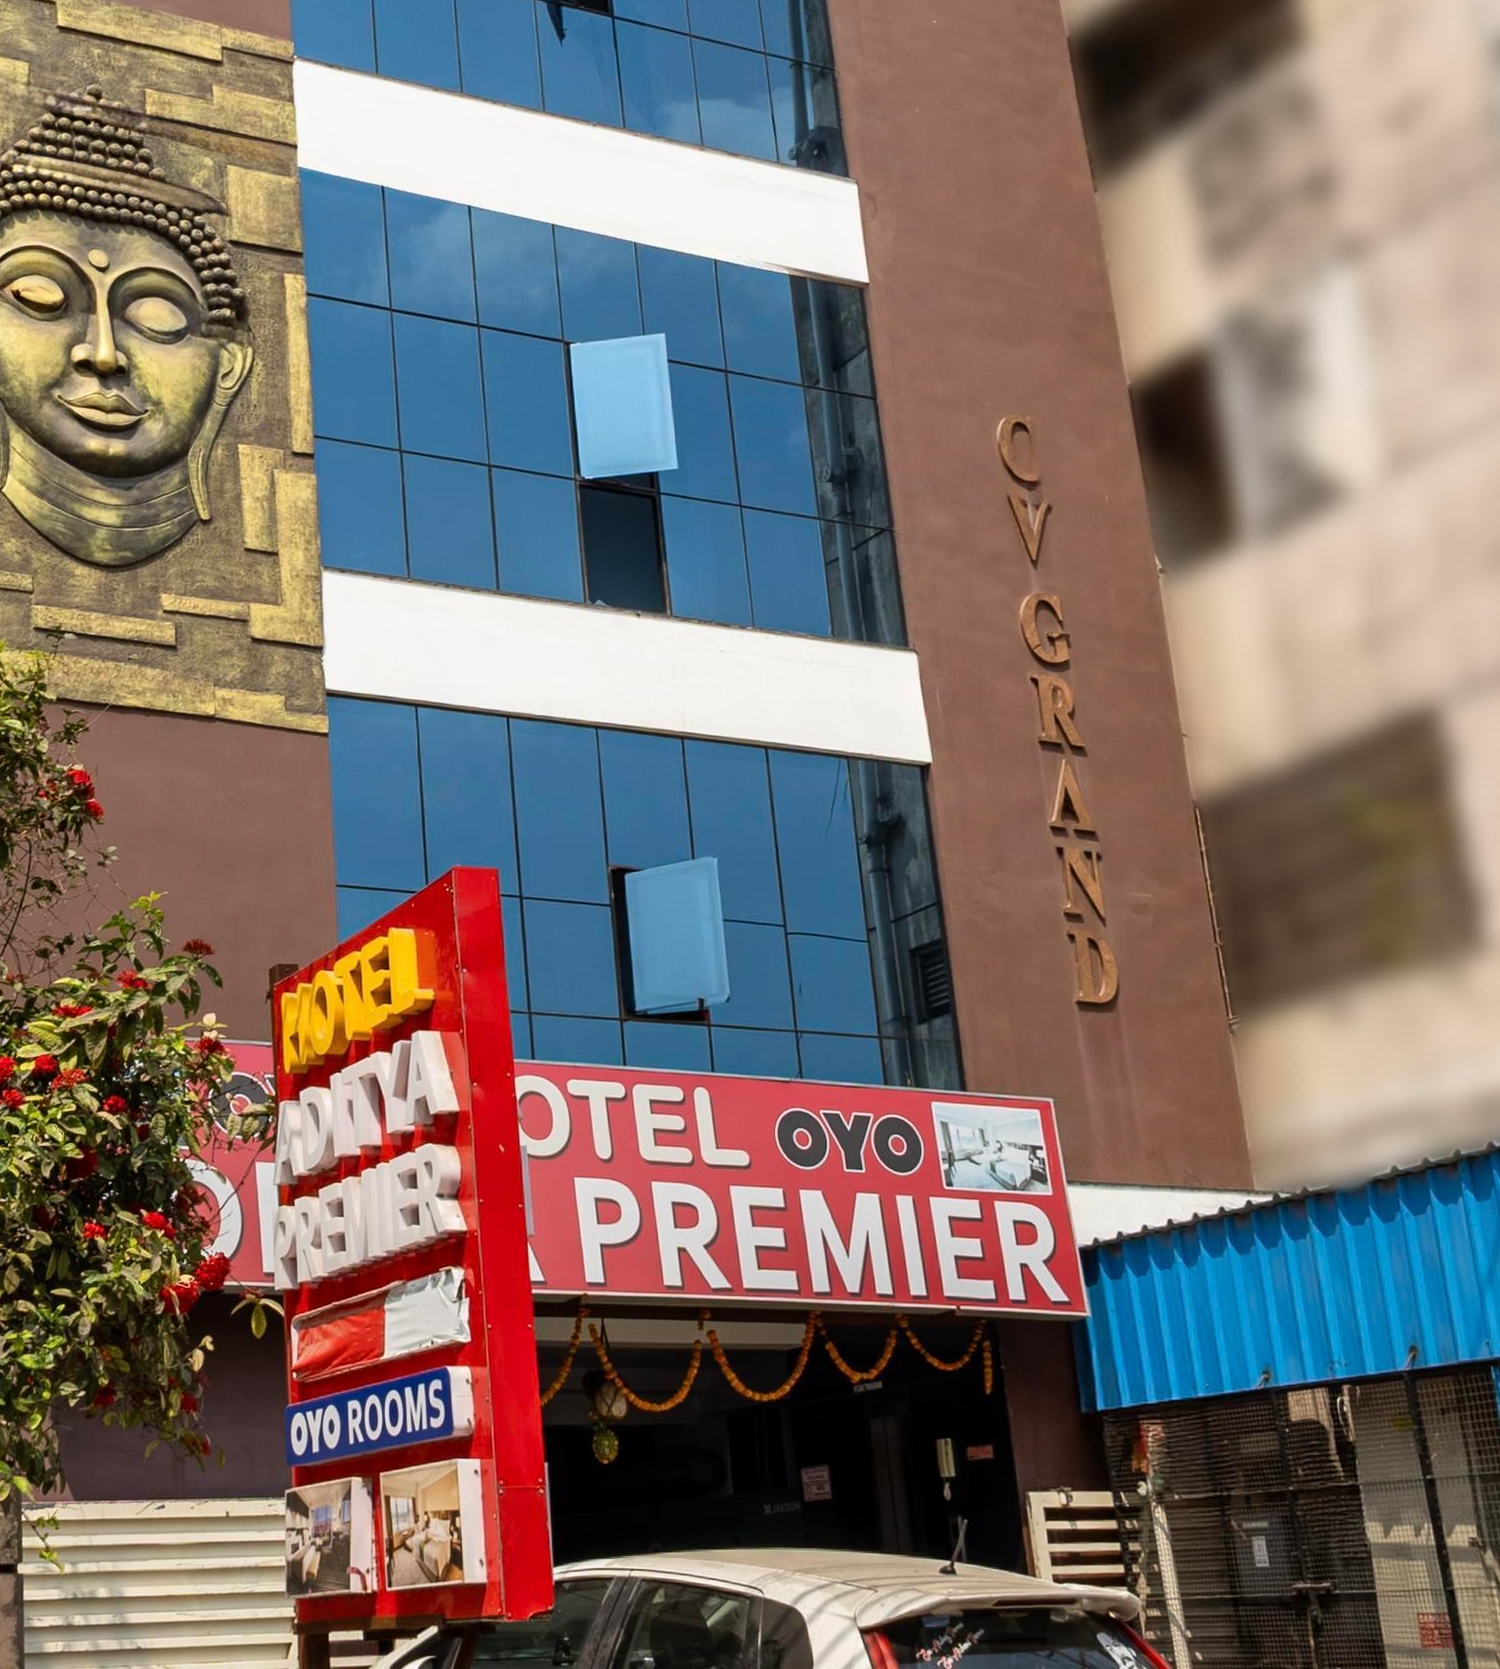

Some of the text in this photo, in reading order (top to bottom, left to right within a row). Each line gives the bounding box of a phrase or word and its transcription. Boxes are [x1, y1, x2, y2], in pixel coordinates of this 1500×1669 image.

[1019, 592, 1119, 1005] GRAND
[281, 927, 436, 1074] HOTEL
[274, 1029, 460, 1186] ADITYA
[514, 1075, 924, 1176] OTEL OYO
[273, 1143, 468, 1291] PREMIER
[573, 1176, 1071, 1303] PREMIER
[290, 1377, 446, 1457] OYO ROOMS
